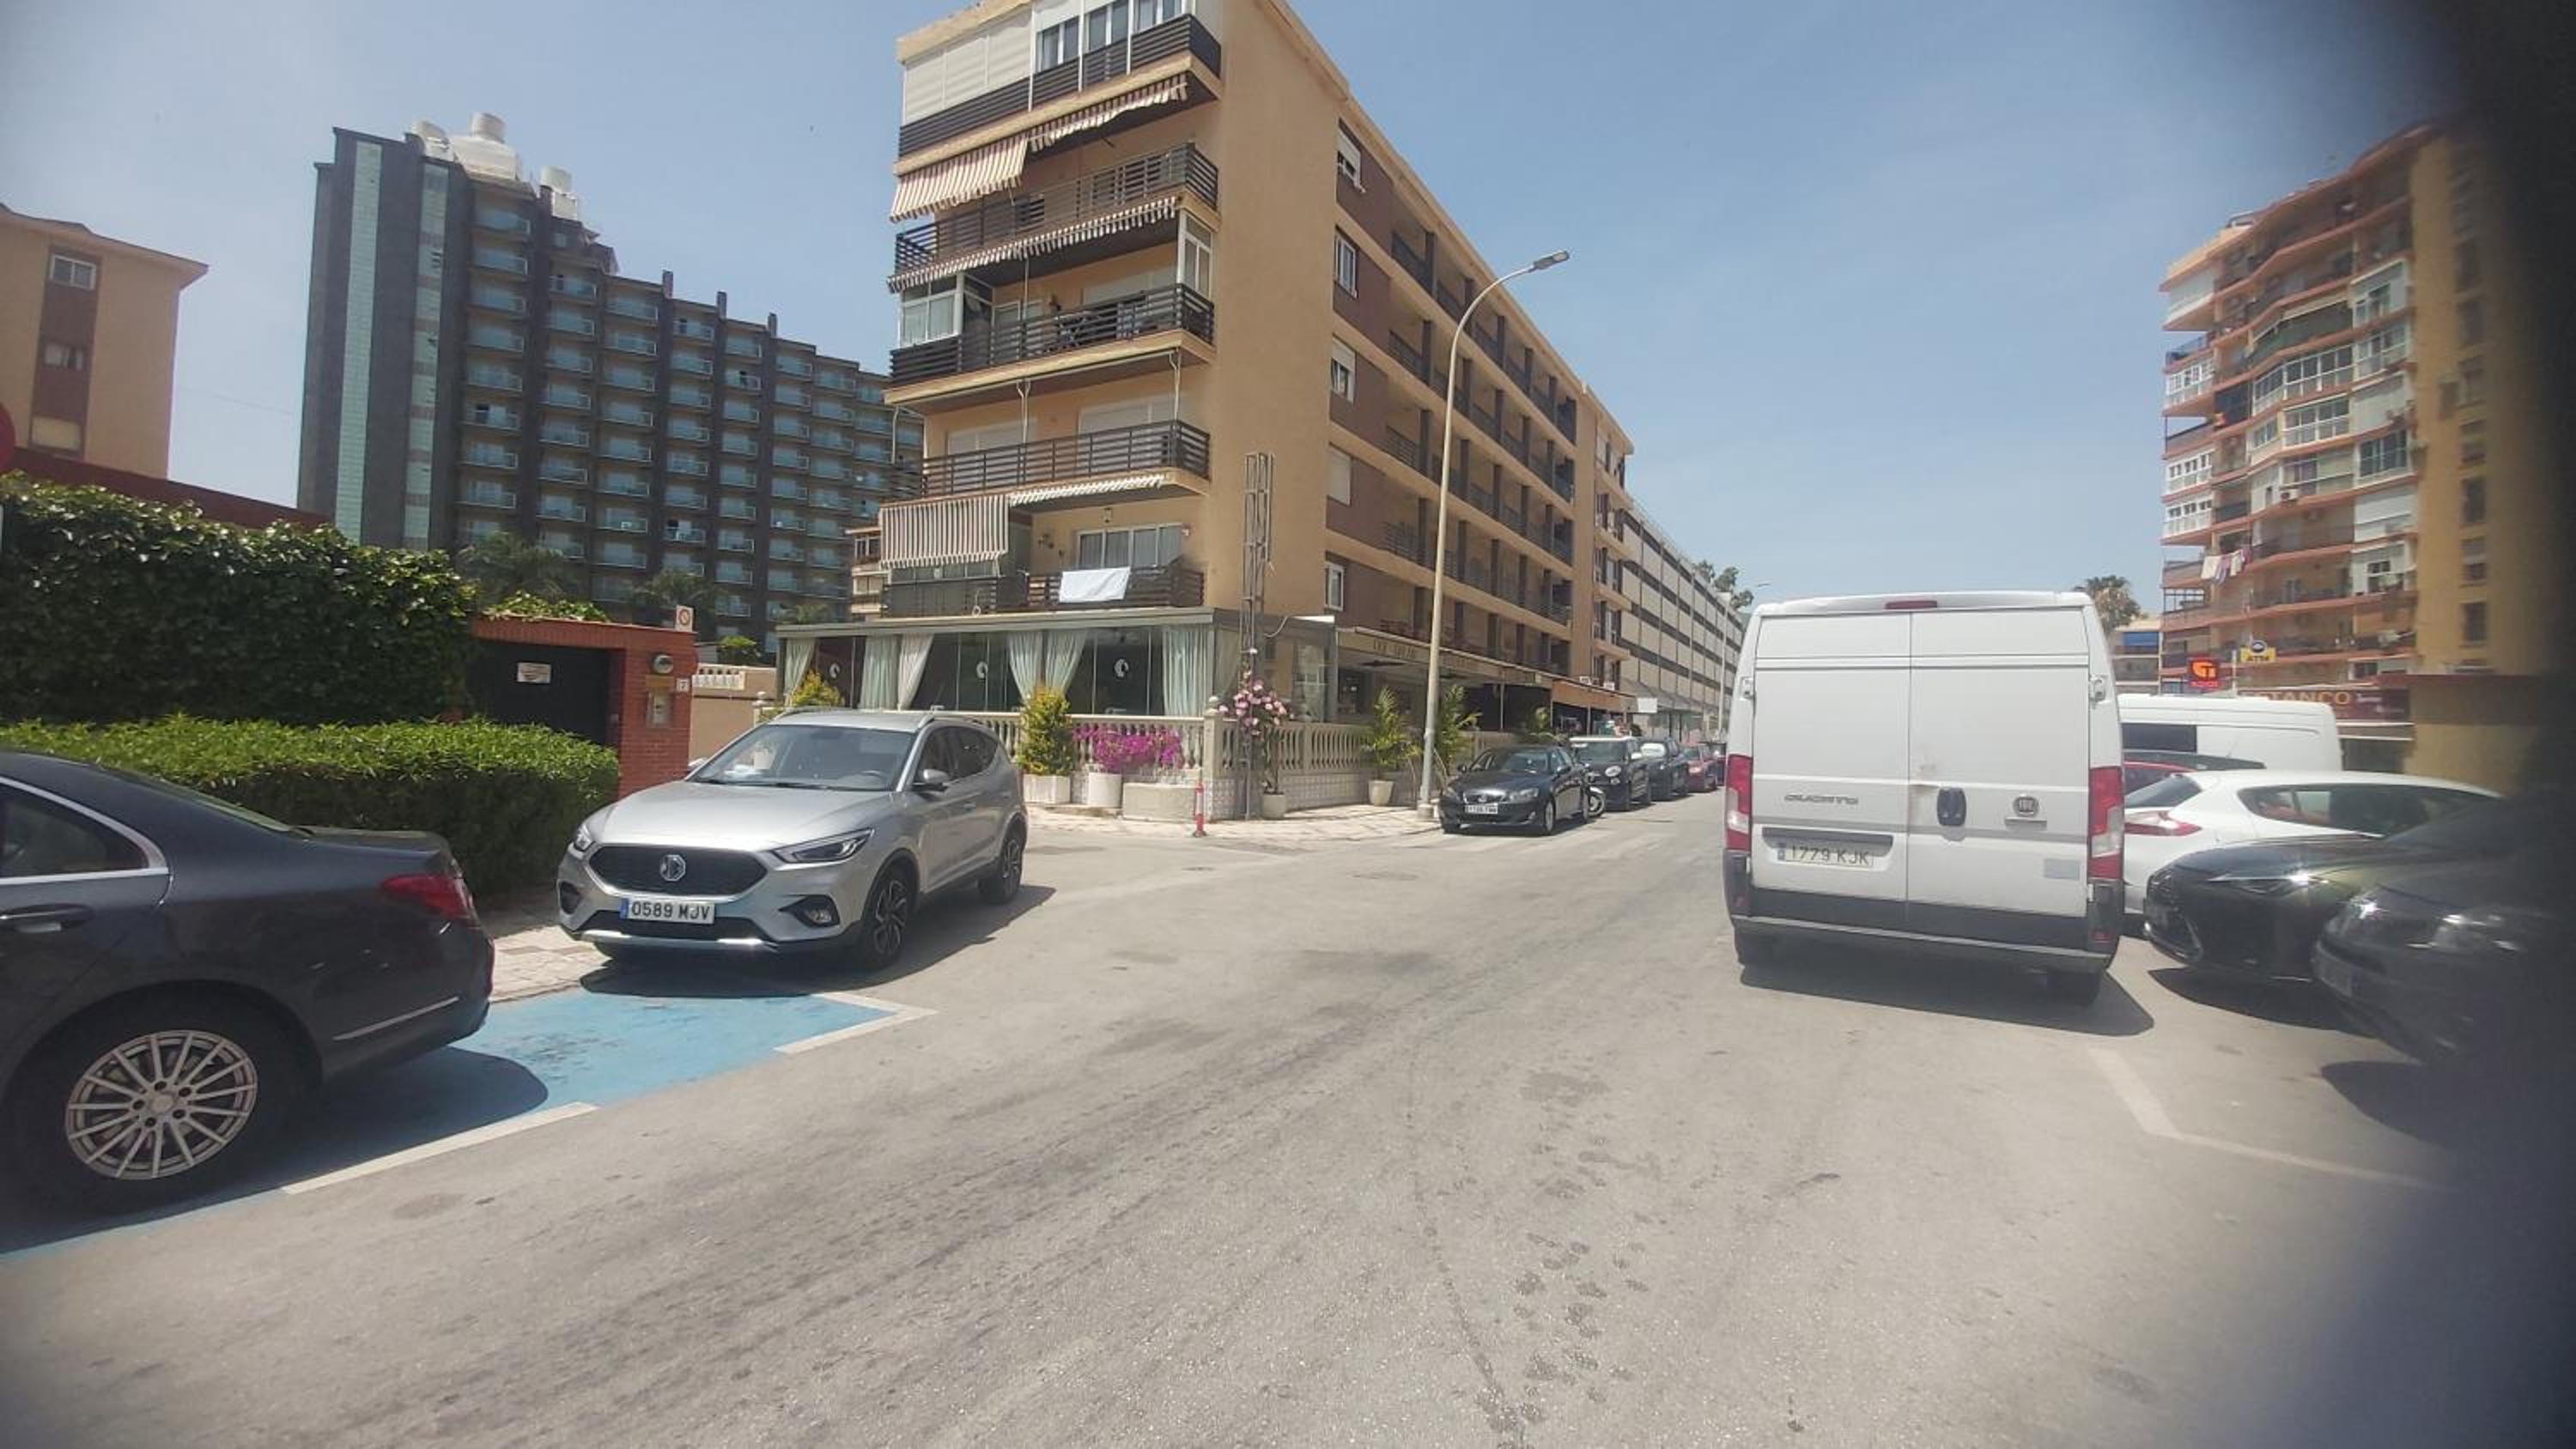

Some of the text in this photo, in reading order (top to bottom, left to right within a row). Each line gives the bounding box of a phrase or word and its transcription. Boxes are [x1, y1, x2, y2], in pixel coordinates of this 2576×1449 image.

[1791, 845, 1869, 865] 1779 KJK
[631, 900, 710, 921] 0589 MJV
